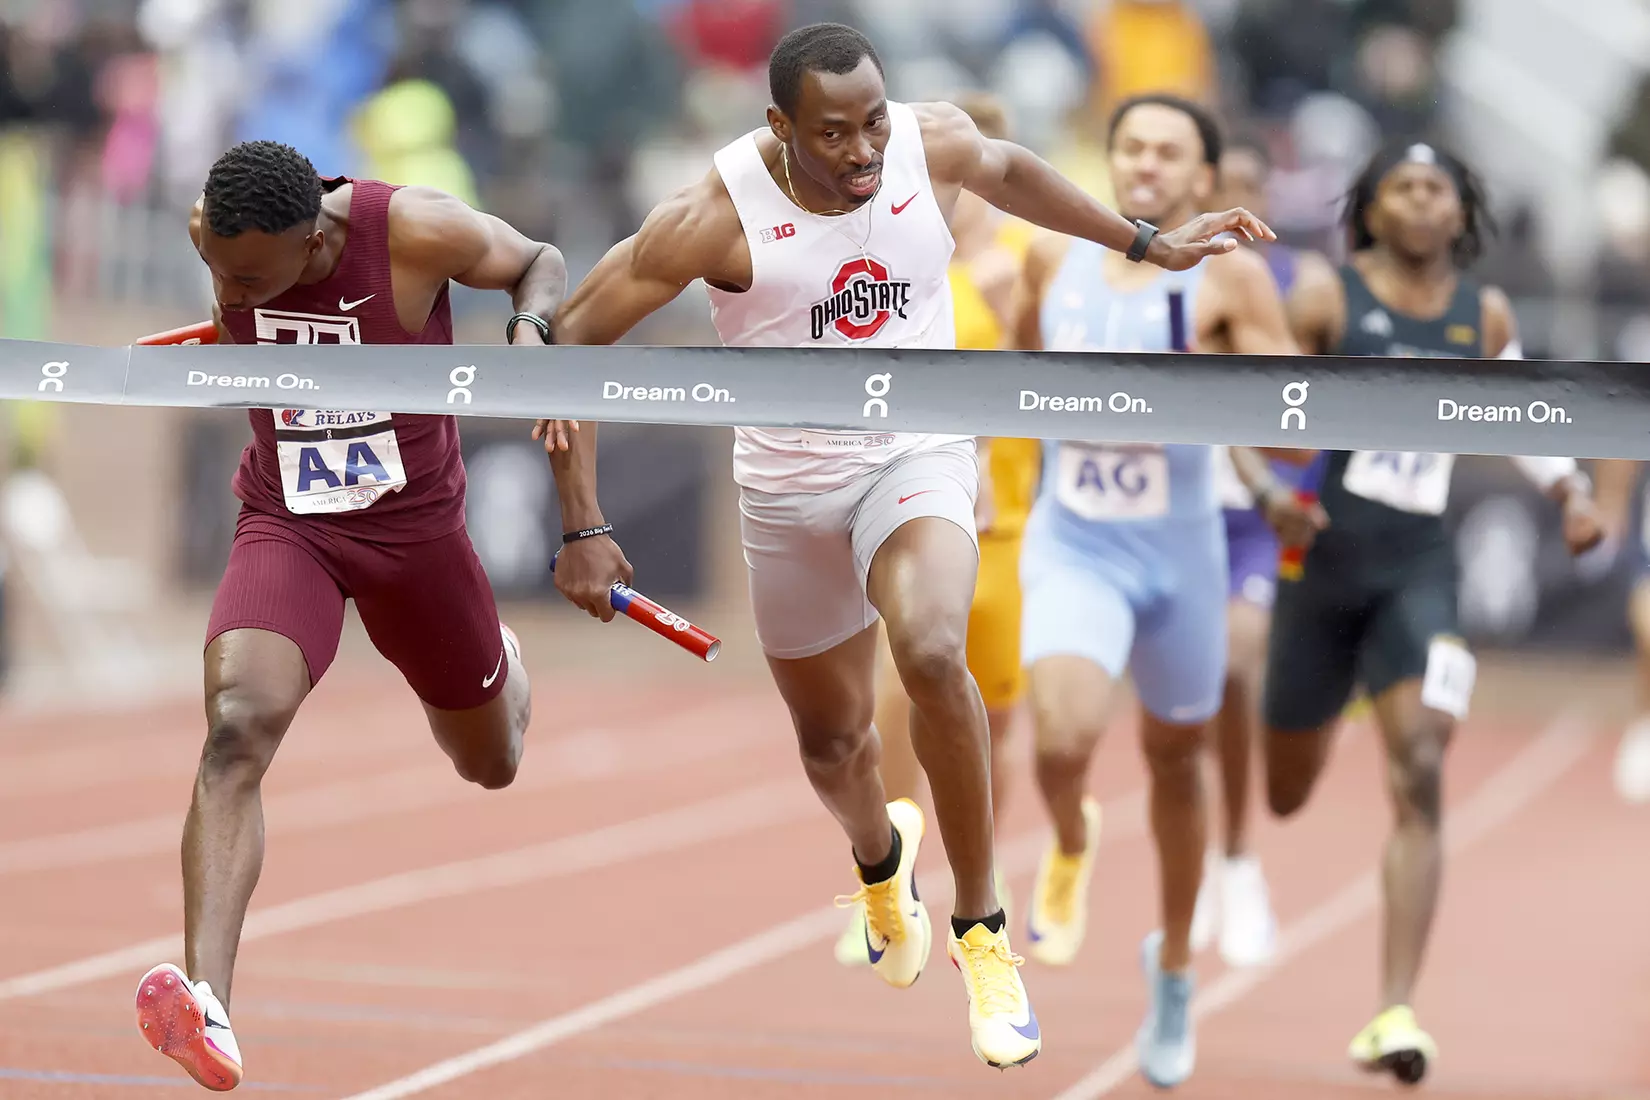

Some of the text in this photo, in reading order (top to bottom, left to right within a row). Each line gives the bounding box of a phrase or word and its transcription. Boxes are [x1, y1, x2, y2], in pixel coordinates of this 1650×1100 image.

[810, 279, 911, 340] OHIO STATE
[186, 370, 320, 391] Dream On.
[602, 381, 736, 403] Dream On.
[1019, 390, 1153, 412] Dream On.
[315, 411, 376, 426] RELAYS
[1438, 399, 1572, 424] Dream On.
[863, 433, 896, 449] 250
[297, 441, 392, 493] AA
[1076, 457, 1149, 498] AG
[312, 487, 378, 506] AMERICA 250
[579, 530, 594, 538] 2026
[594, 527, 603, 535] Big
[654, 607, 691, 632] 250
